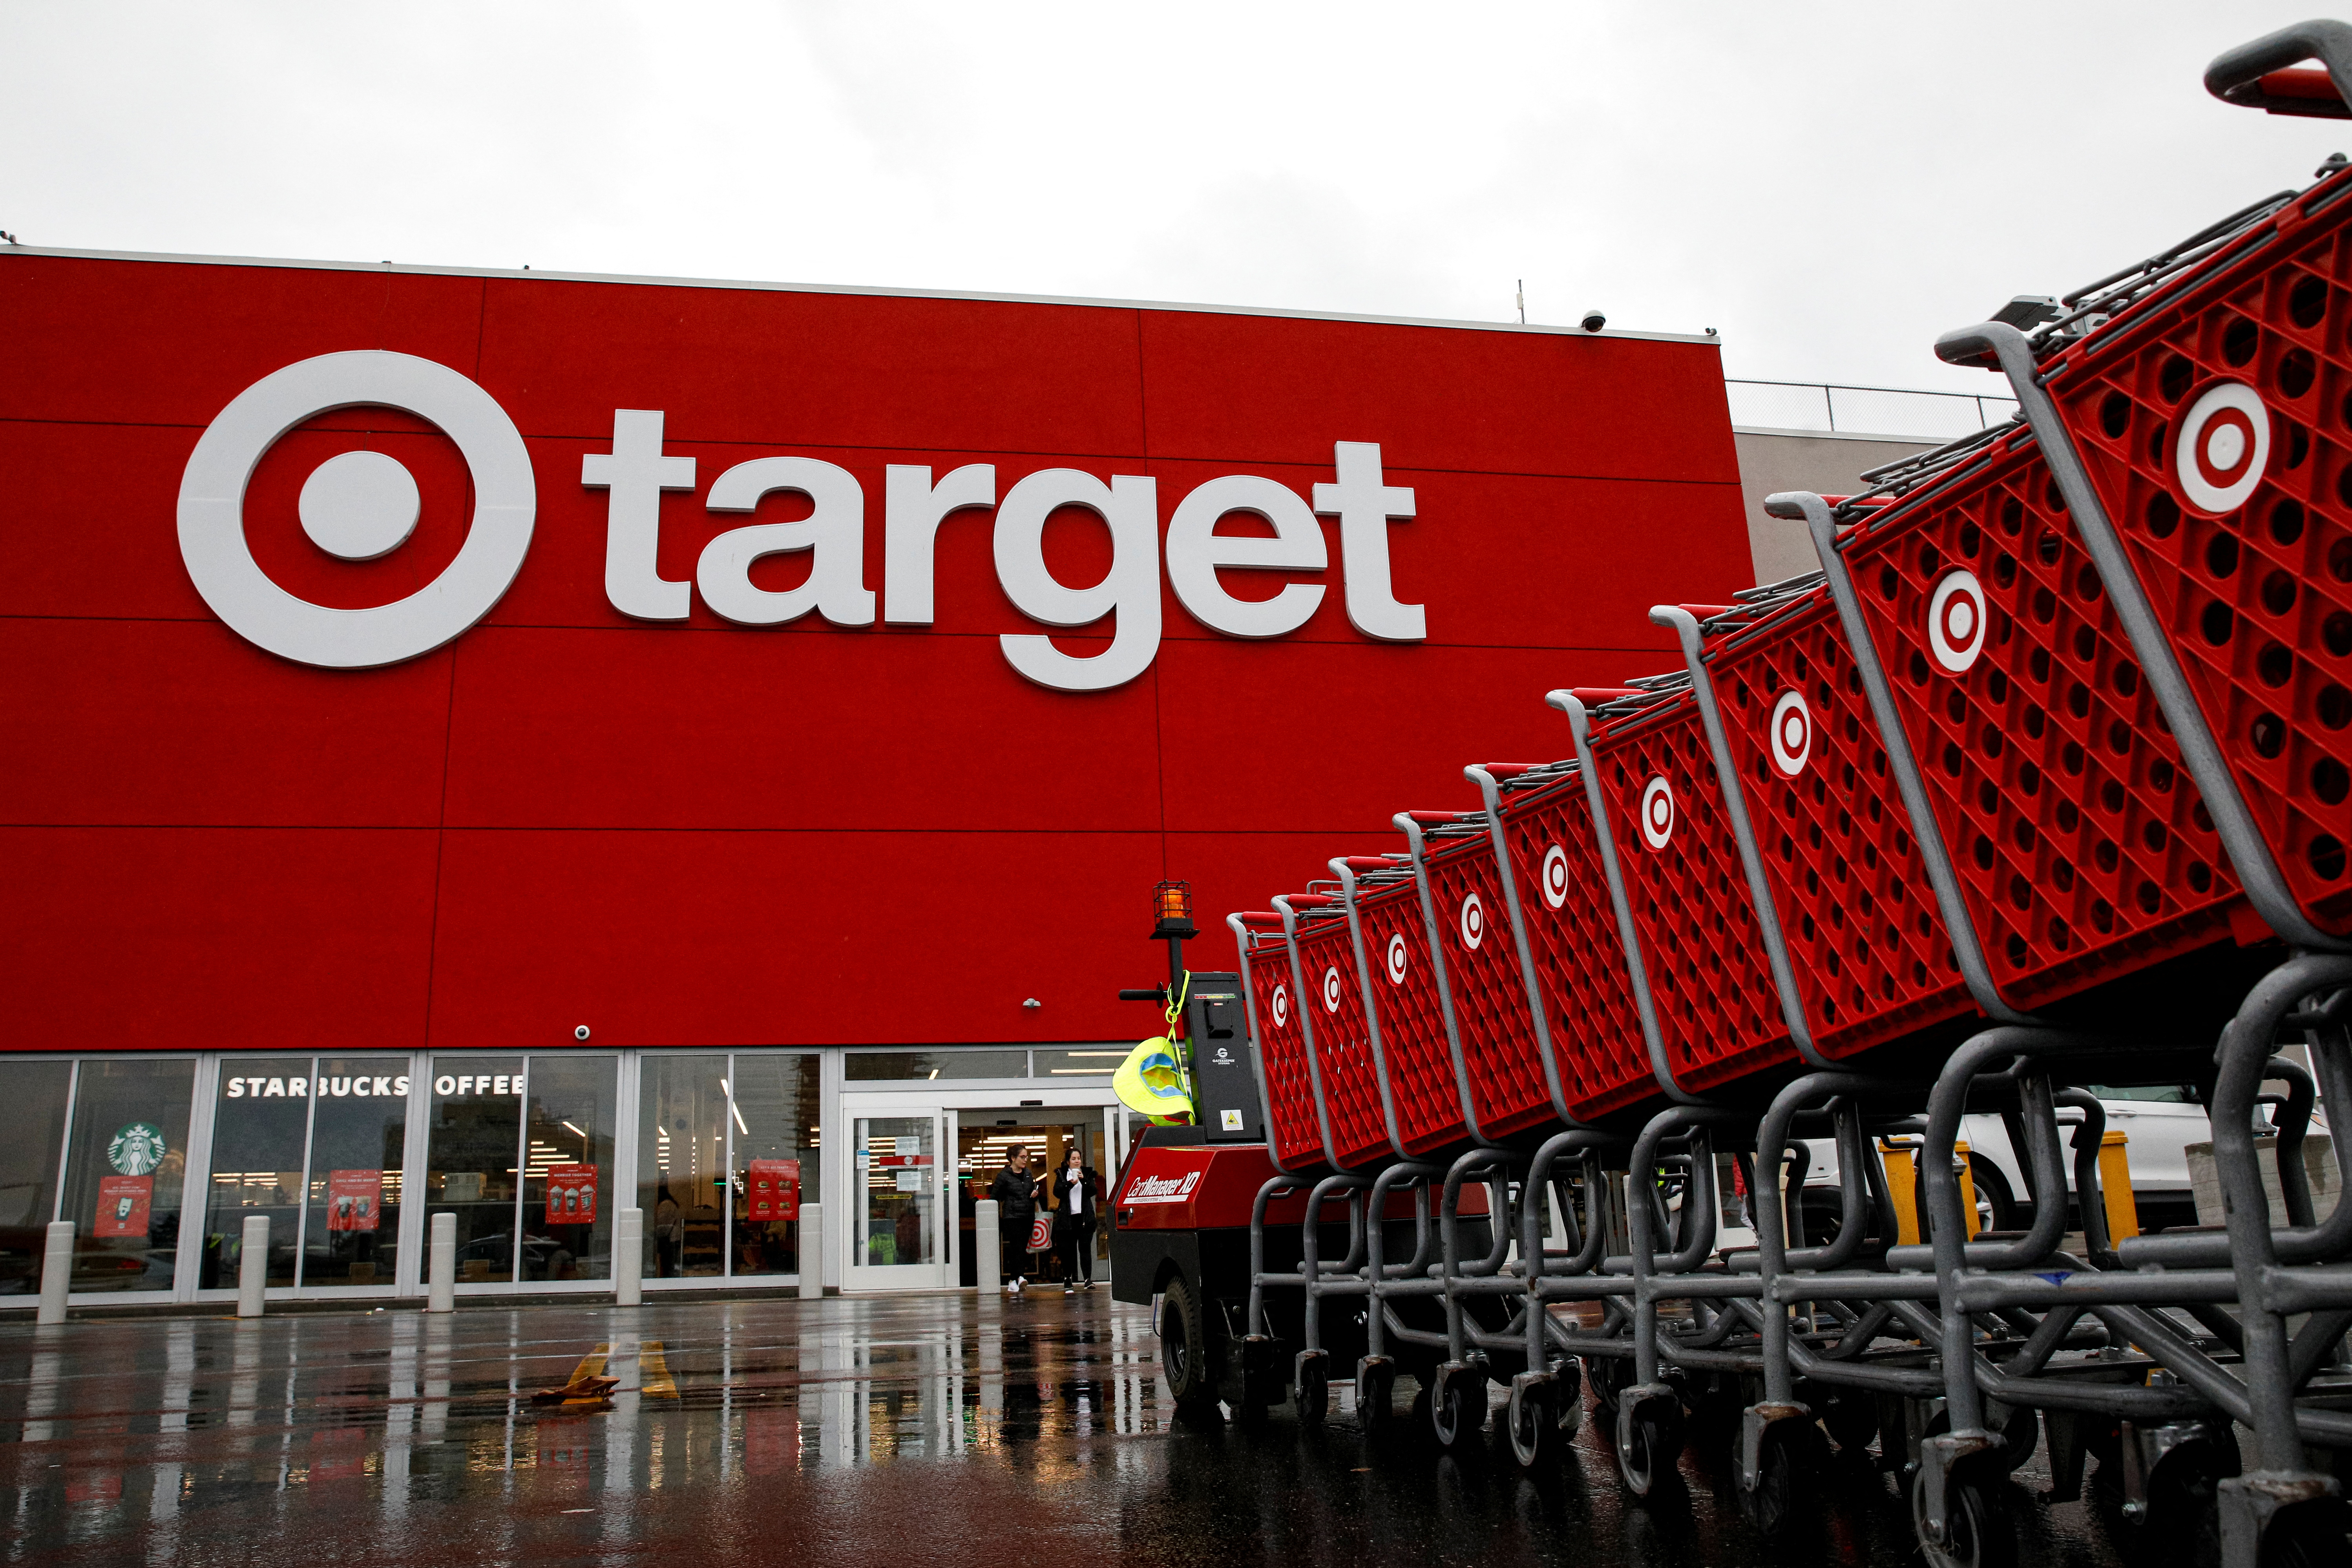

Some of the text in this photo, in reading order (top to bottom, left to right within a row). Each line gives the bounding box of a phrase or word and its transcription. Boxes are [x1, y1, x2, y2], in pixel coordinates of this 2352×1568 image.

[581, 409, 1426, 692] target
[228, 1075, 523, 1097] STARBUCKS OFFEE
[1177, 1171, 1201, 1194] XD
